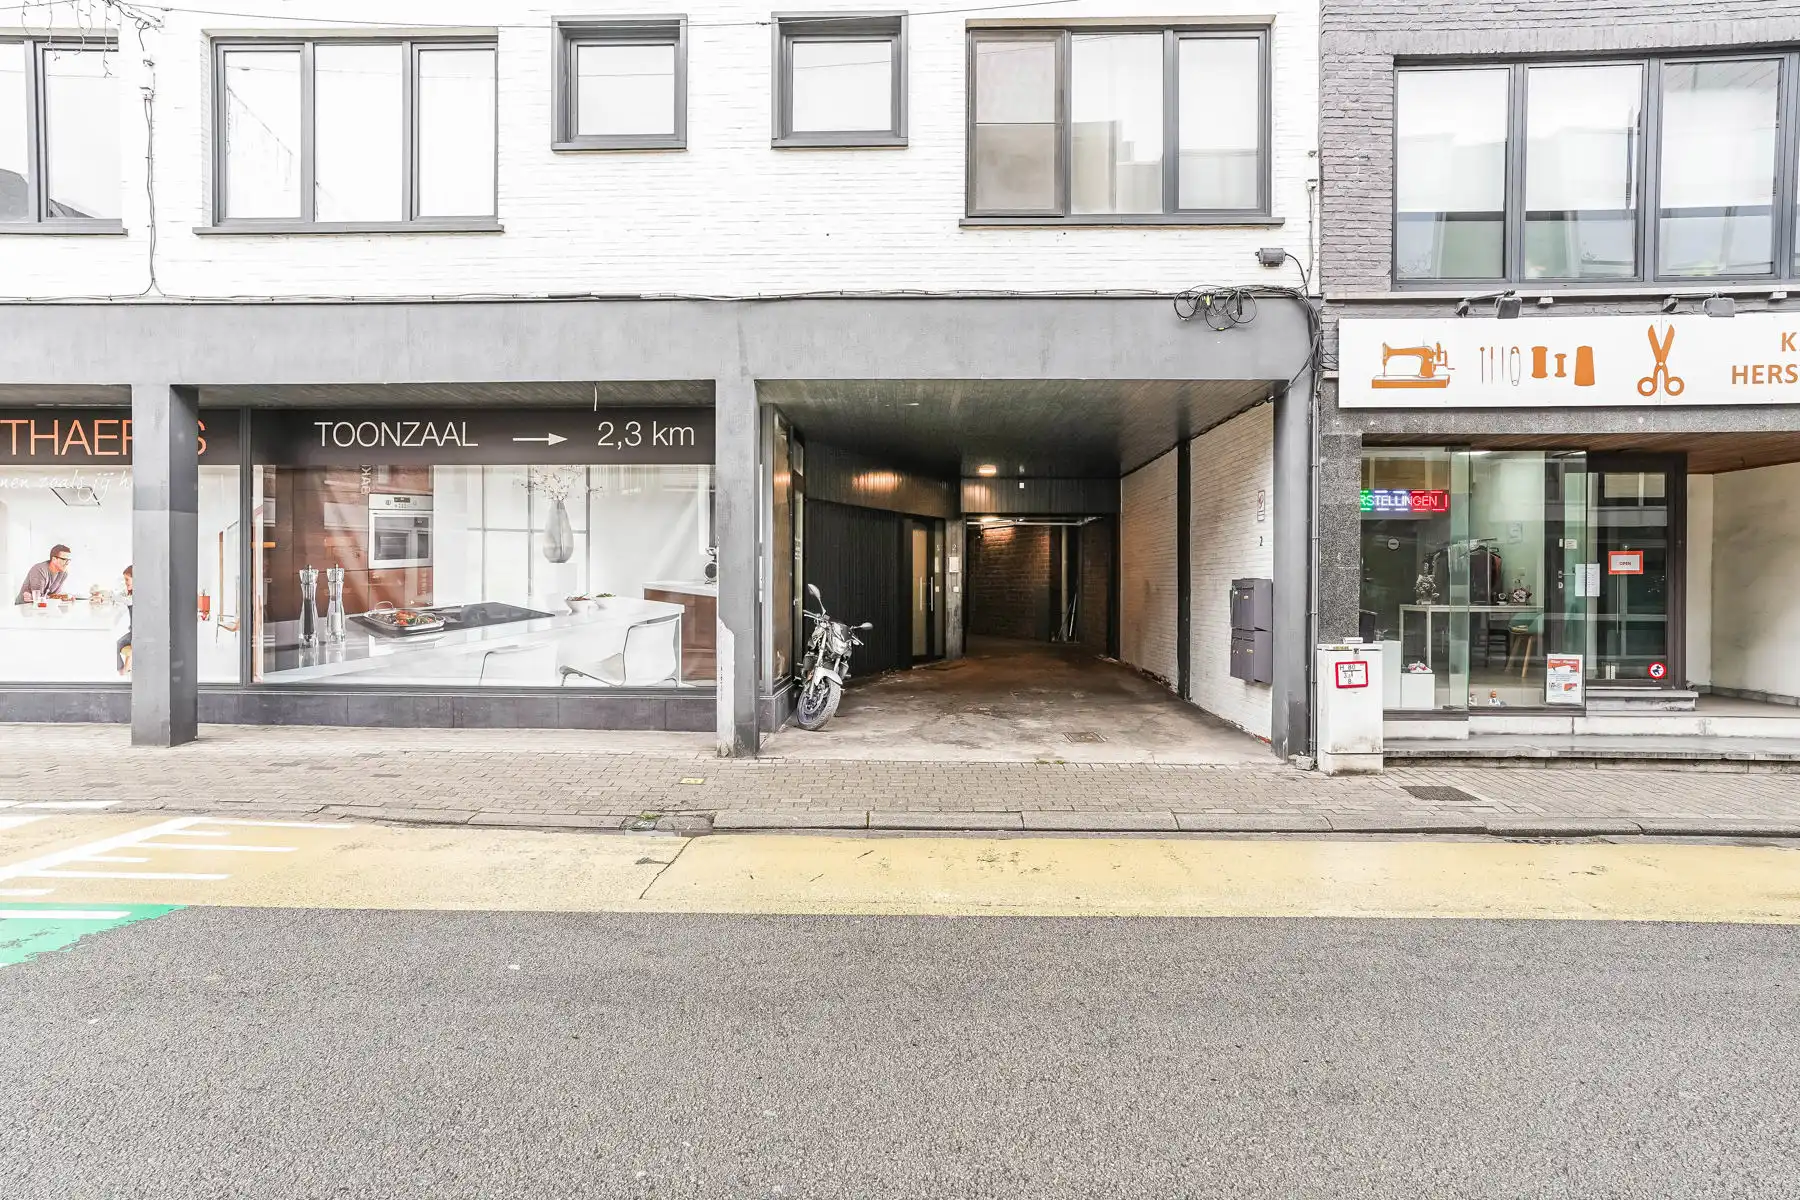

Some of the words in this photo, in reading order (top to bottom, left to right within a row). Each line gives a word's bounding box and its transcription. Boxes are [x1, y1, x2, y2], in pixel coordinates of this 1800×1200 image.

[1781, 332, 1799, 352] K
[314, 421, 479, 447] TOONZAAL
[597, 421, 642, 450] 2,3
[653, 421, 695, 446] km
